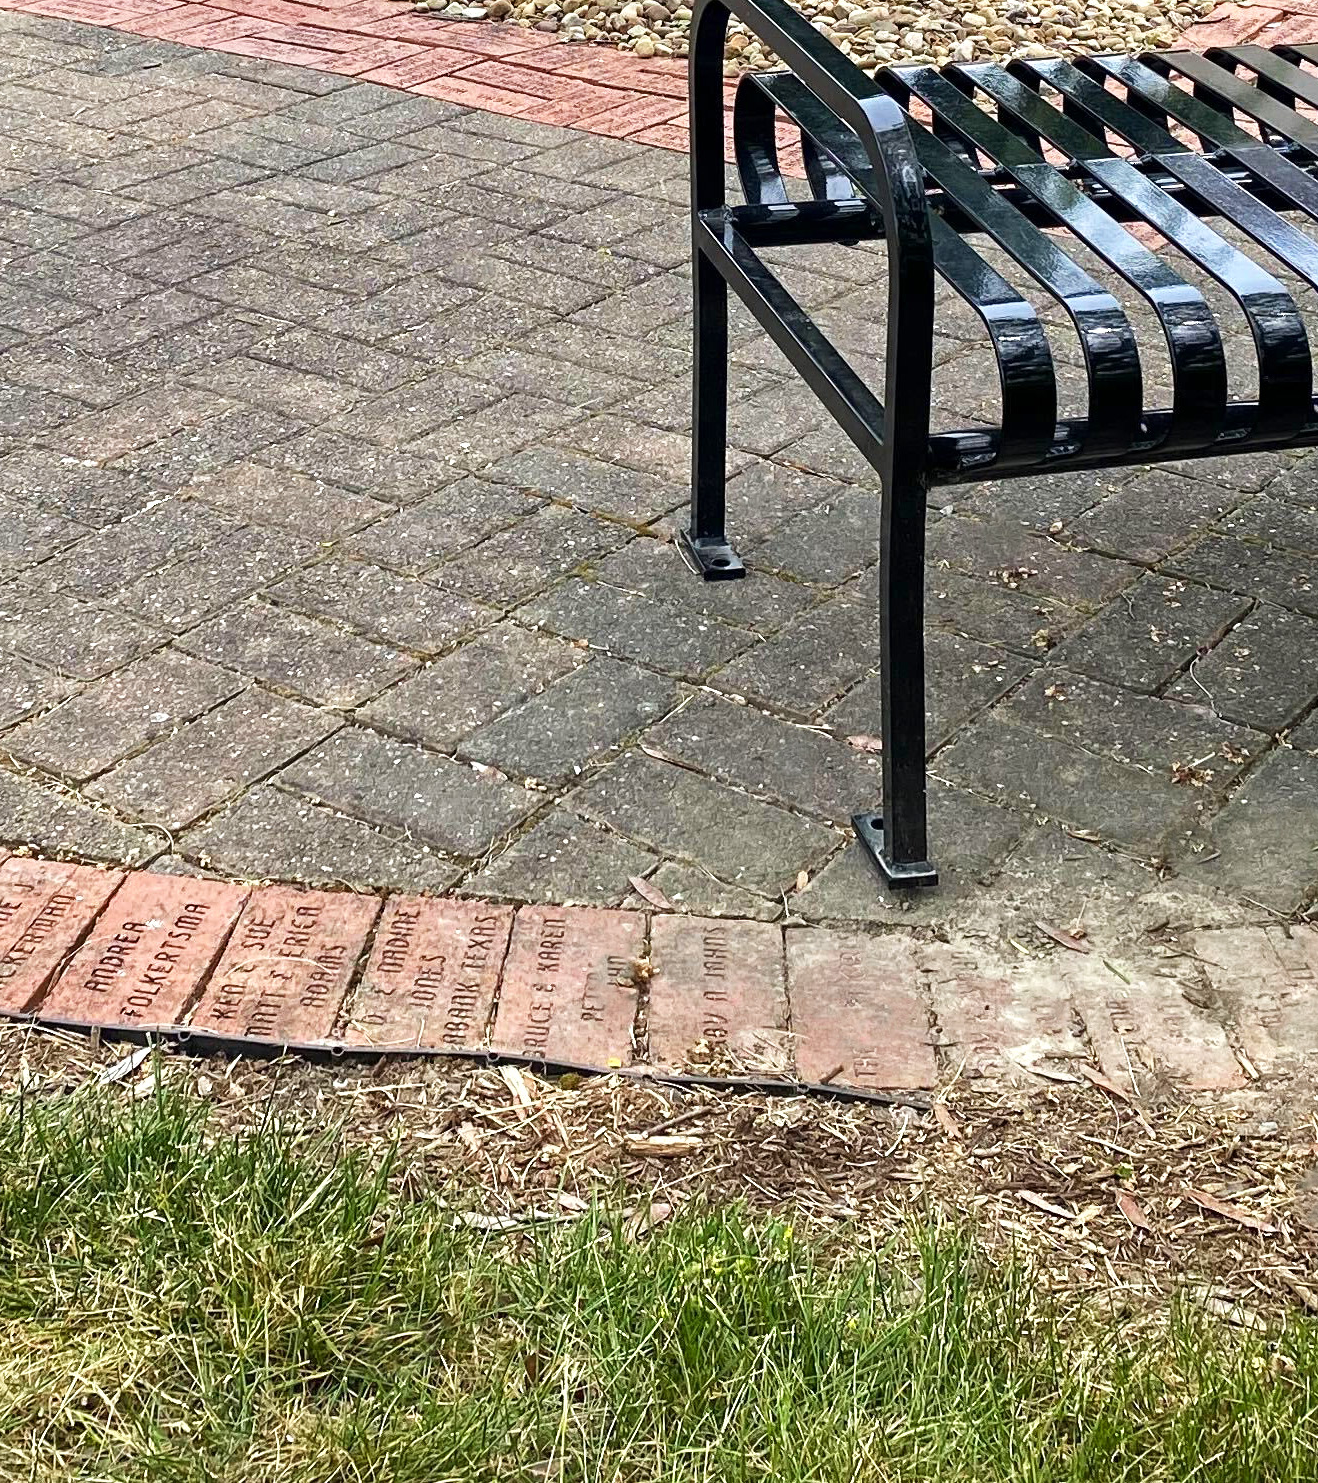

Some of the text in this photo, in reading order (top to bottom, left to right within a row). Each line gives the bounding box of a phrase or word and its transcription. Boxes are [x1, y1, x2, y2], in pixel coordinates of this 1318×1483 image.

[83, 921, 149, 993] ANDREA
[120, 903, 211, 1018] FOLKERTSMA
[277, 906, 323, 958] ERICA
[376, 908, 421, 973] NADINE
[460, 915, 499, 969] TEXAS
[536, 918, 566, 973] KAREN
[209, 983, 247, 1020] KEN
[240, 919, 277, 951] SUE
[409, 955, 447, 1010] JONES
[522, 1002, 554, 1059] BRUCE
